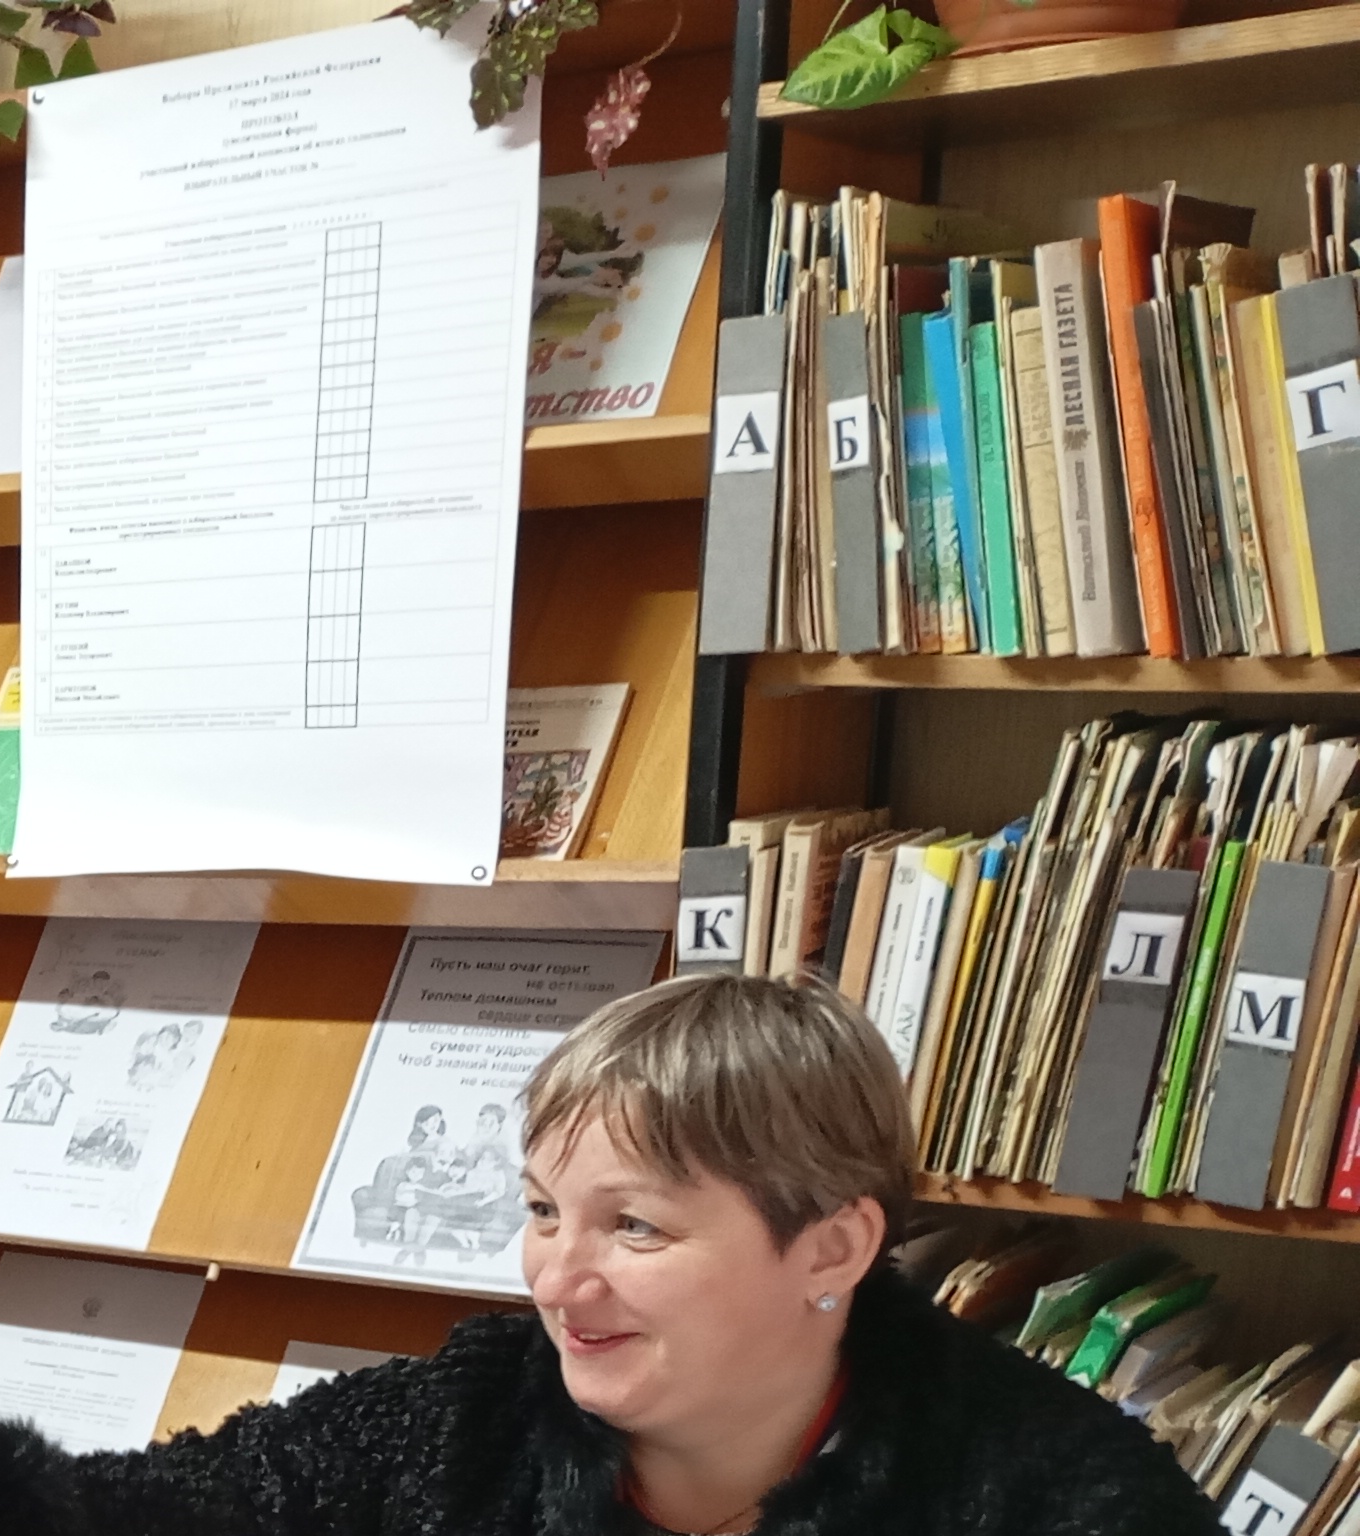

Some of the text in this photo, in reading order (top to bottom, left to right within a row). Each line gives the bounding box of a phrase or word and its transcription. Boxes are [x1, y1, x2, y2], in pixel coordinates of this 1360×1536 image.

[1053, 283, 1086, 427] ЛЕСНАЯ ГАЗЕТА
[726, 410, 770, 457] А
[1297, 384, 1346, 438] Г
[834, 416, 860, 466] Б
[686, 907, 734, 950] К
[1109, 932, 1163, 979] Л
[1231, 990, 1298, 1041] М
